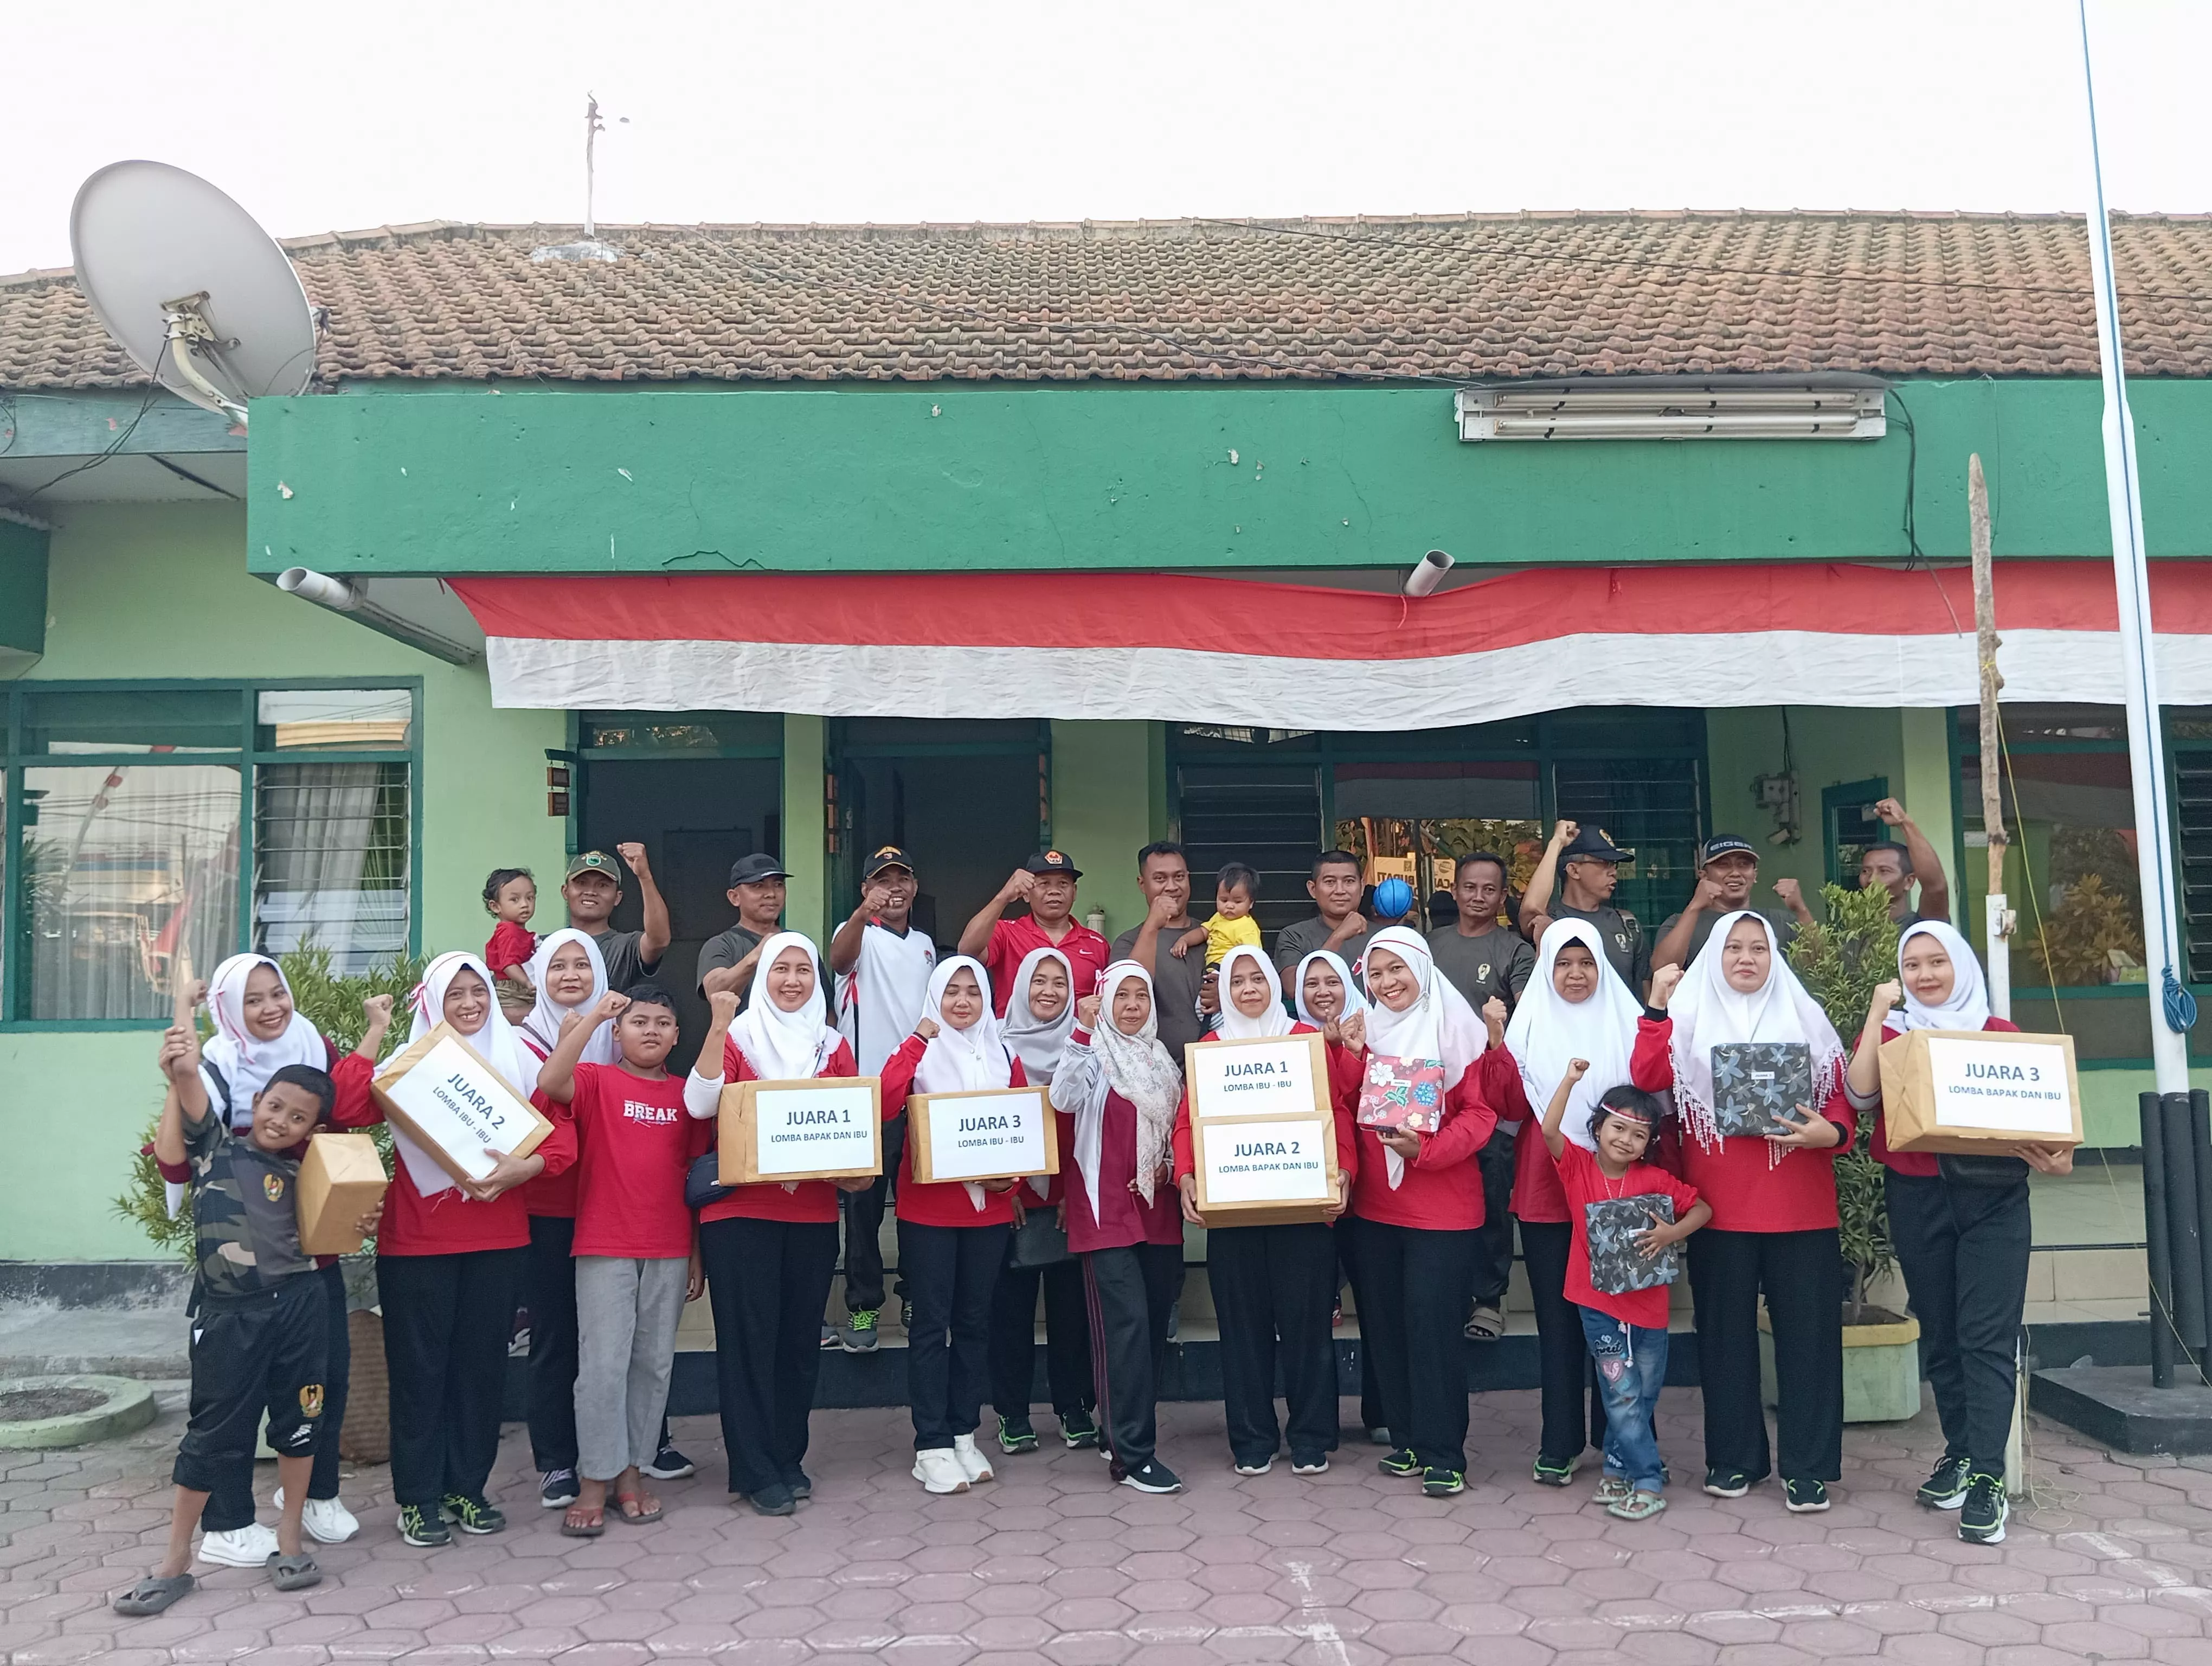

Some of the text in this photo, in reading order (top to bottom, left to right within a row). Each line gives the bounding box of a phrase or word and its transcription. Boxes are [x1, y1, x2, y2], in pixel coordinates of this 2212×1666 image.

[1710, 841, 1752, 851] EIGER
[1224, 1061, 1288, 1077] JUARA 1
[1965, 1063, 2040, 1081] JUARA 3
[1224, 1084, 1255, 1092] LOMBA
[1949, 1086, 2061, 1100] LOMBA BAPAK DAN IBU
[447, 1073, 505, 1130] JUARA 2
[433, 1086, 460, 1115] LOMBA
[459, 1112, 475, 1127] IBU
[475, 1129, 492, 1143] IBU
[623, 1103, 678, 1122] BREAK
[786, 1109, 851, 1126] JUARA 1
[959, 1114, 1021, 1132] JUARA 3
[771, 1130, 868, 1143] LOMBA BAPAK DAN IBU
[958, 1139, 988, 1148] LOMBA
[989, 1137, 1004, 1145] IBU
[1010, 1136, 1024, 1144] IBU
[1234, 1142, 1300, 1157] JUARA 2
[1219, 1161, 1319, 1173] LOMBA BAPAK DAN IBU
